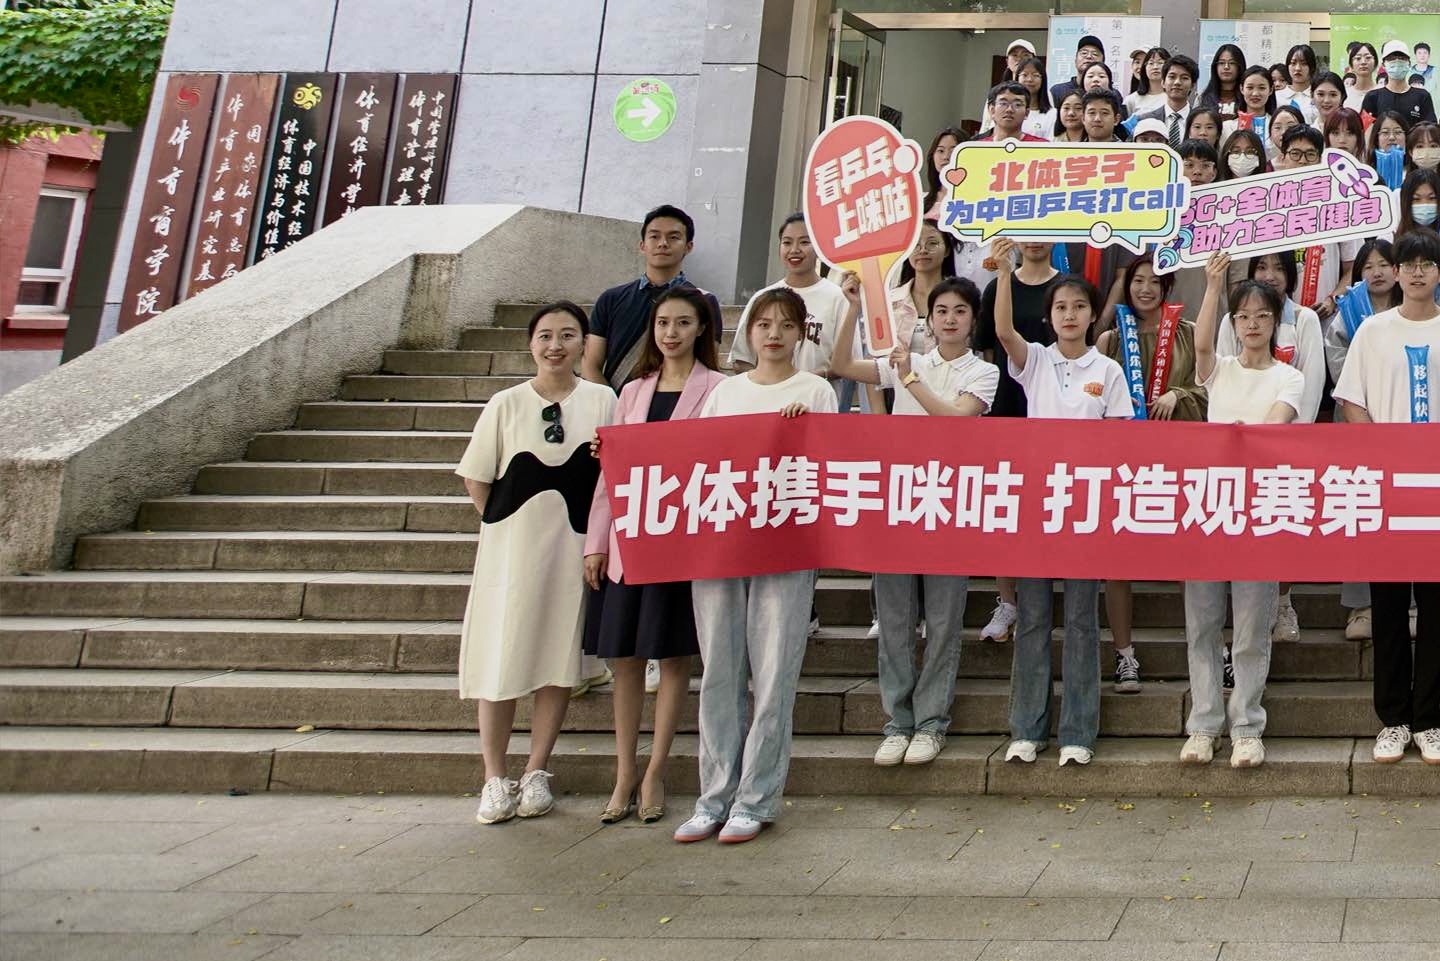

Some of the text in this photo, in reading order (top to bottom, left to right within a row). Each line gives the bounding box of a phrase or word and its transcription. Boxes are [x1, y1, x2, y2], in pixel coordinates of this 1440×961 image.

[194, 93, 244, 294] 体育产业研究基
[284, 138, 317, 248] 中国技术经
[813, 136, 892, 204] 看乒乓
[989, 152, 1135, 192] 北体学子
[833, 180, 910, 247] 上咪咕
[945, 182, 1185, 226] 为中国乒乓打call
[1189, 196, 1383, 255] 助力全民健身
[1413, 364, 1428, 418] 移起快
[613, 455, 1025, 539] 北体携手咪咕
